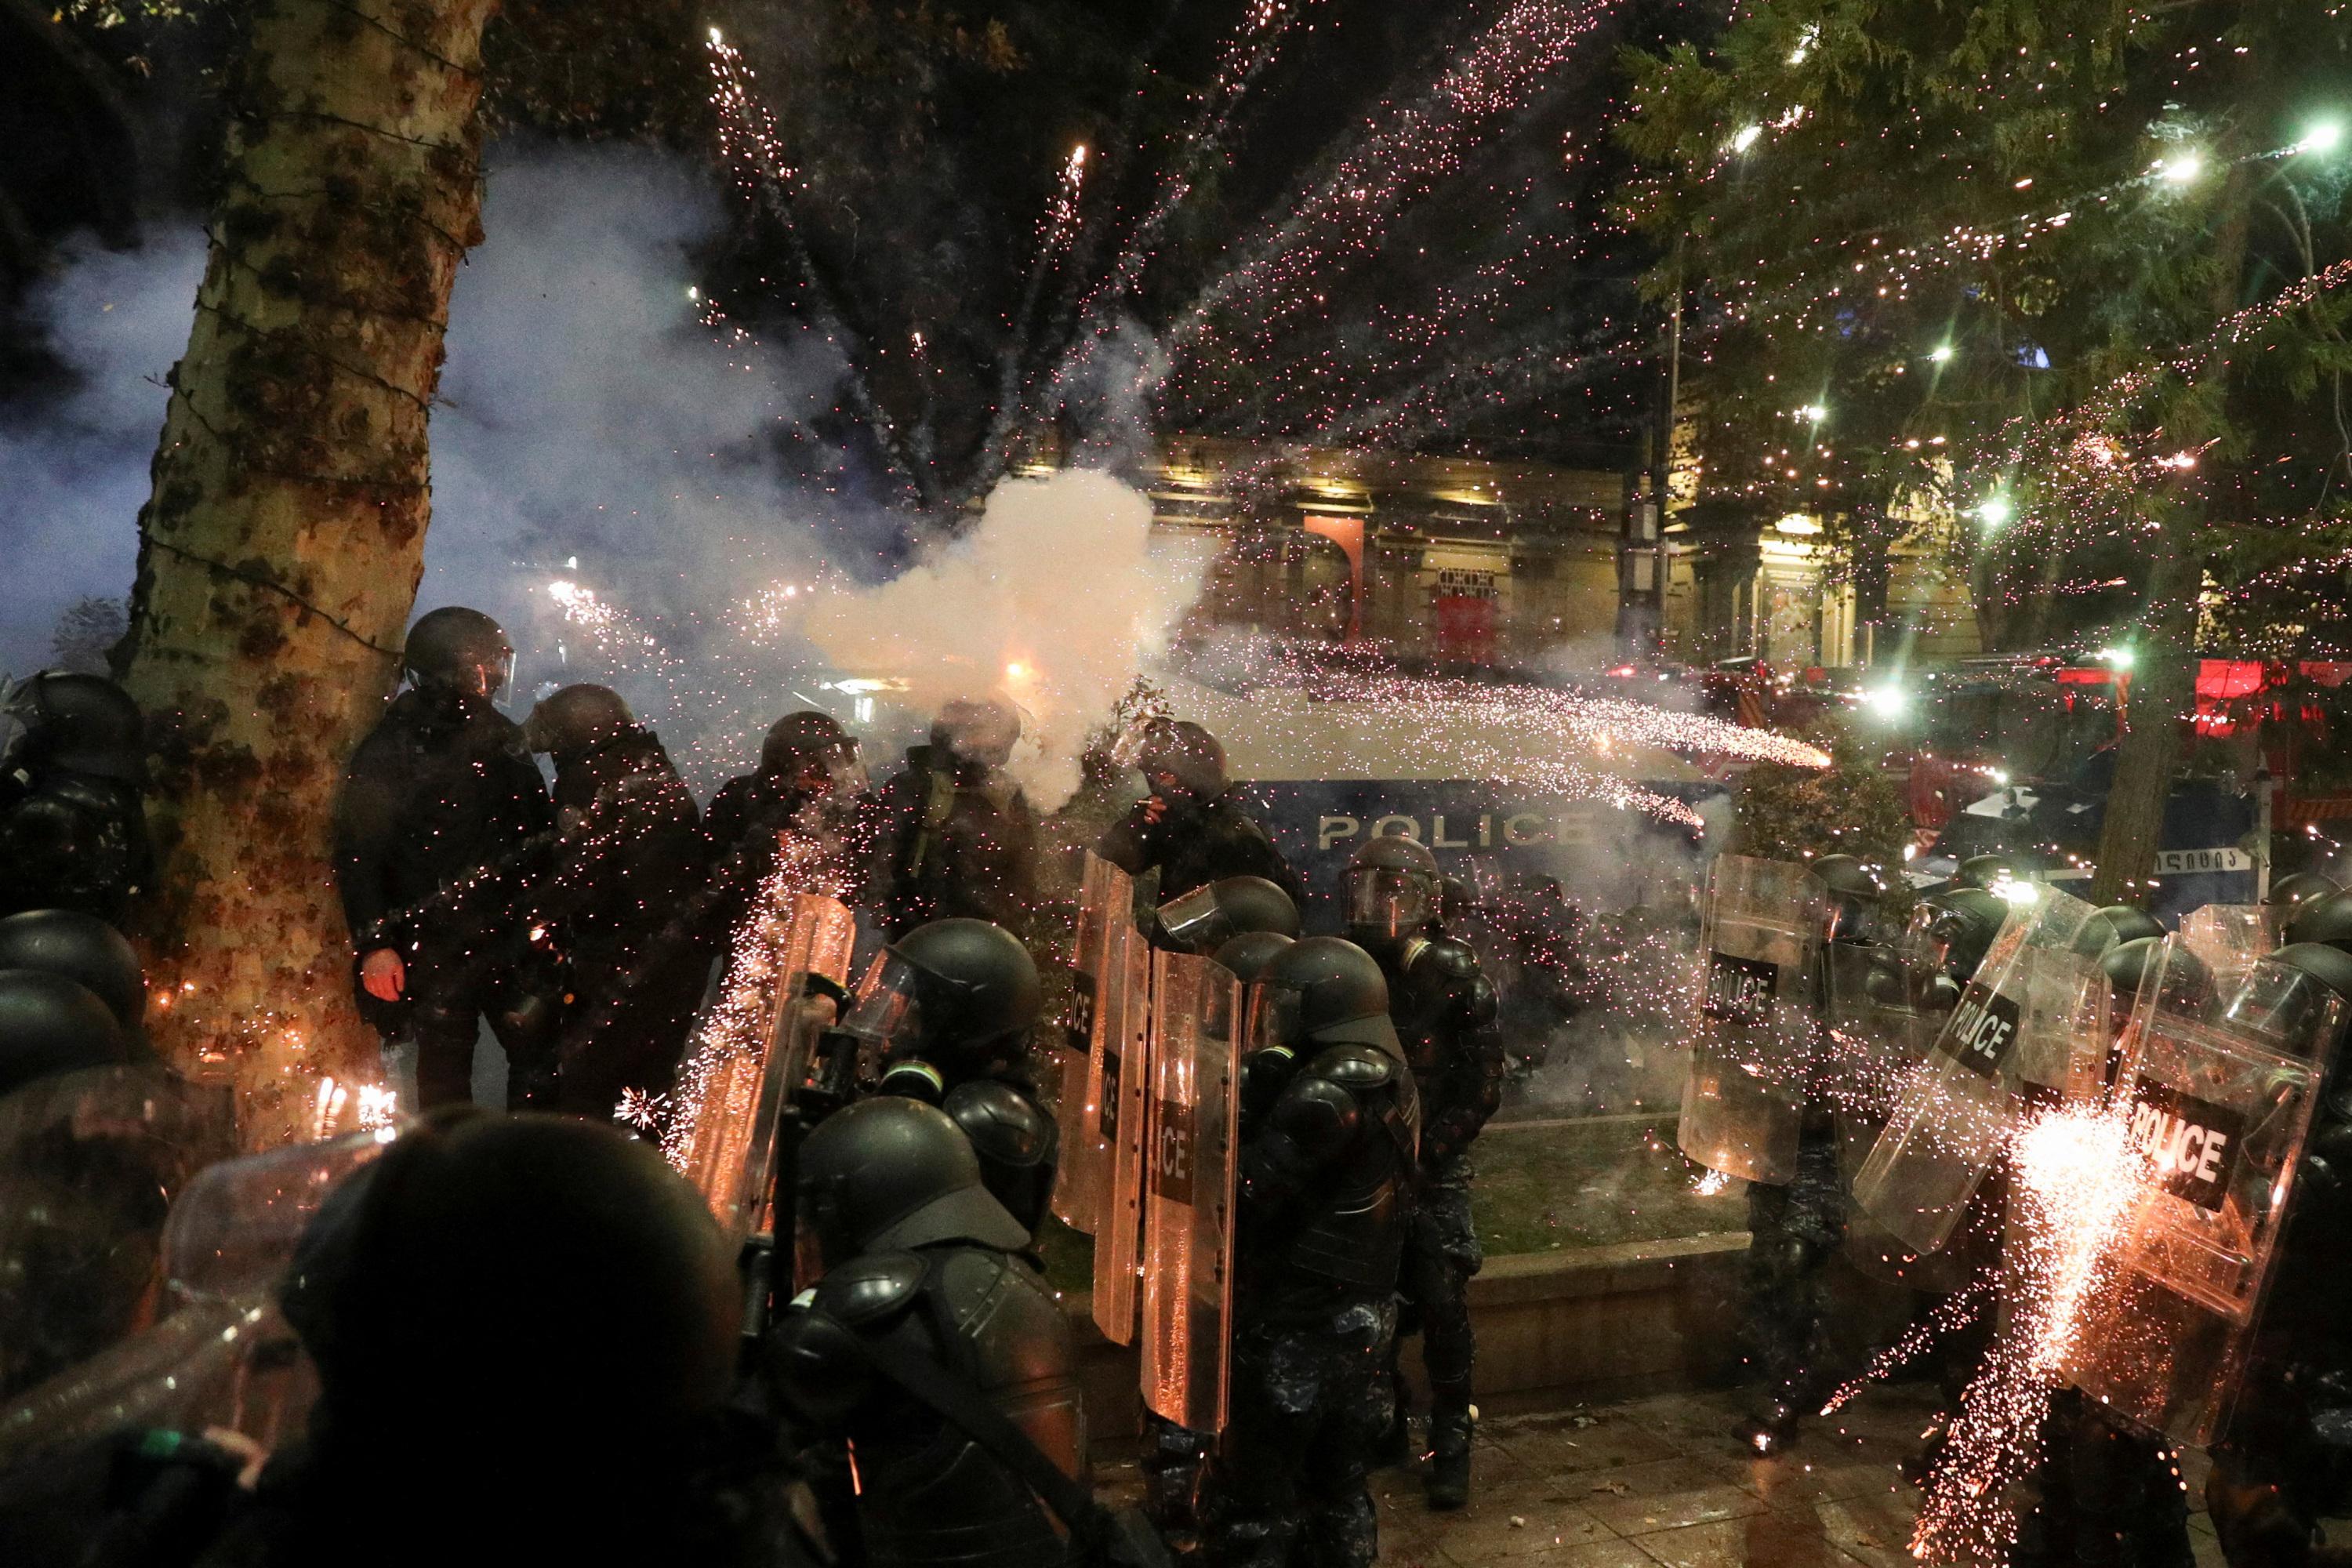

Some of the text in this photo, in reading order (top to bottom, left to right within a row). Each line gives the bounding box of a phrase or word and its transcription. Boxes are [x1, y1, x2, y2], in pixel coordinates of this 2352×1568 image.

[1319, 814, 1593, 851] POLICE
[1709, 969, 1768, 1011] POLICE
[1951, 1000, 2012, 1059] POLICE
[2129, 1101, 2227, 1183] POLICE
